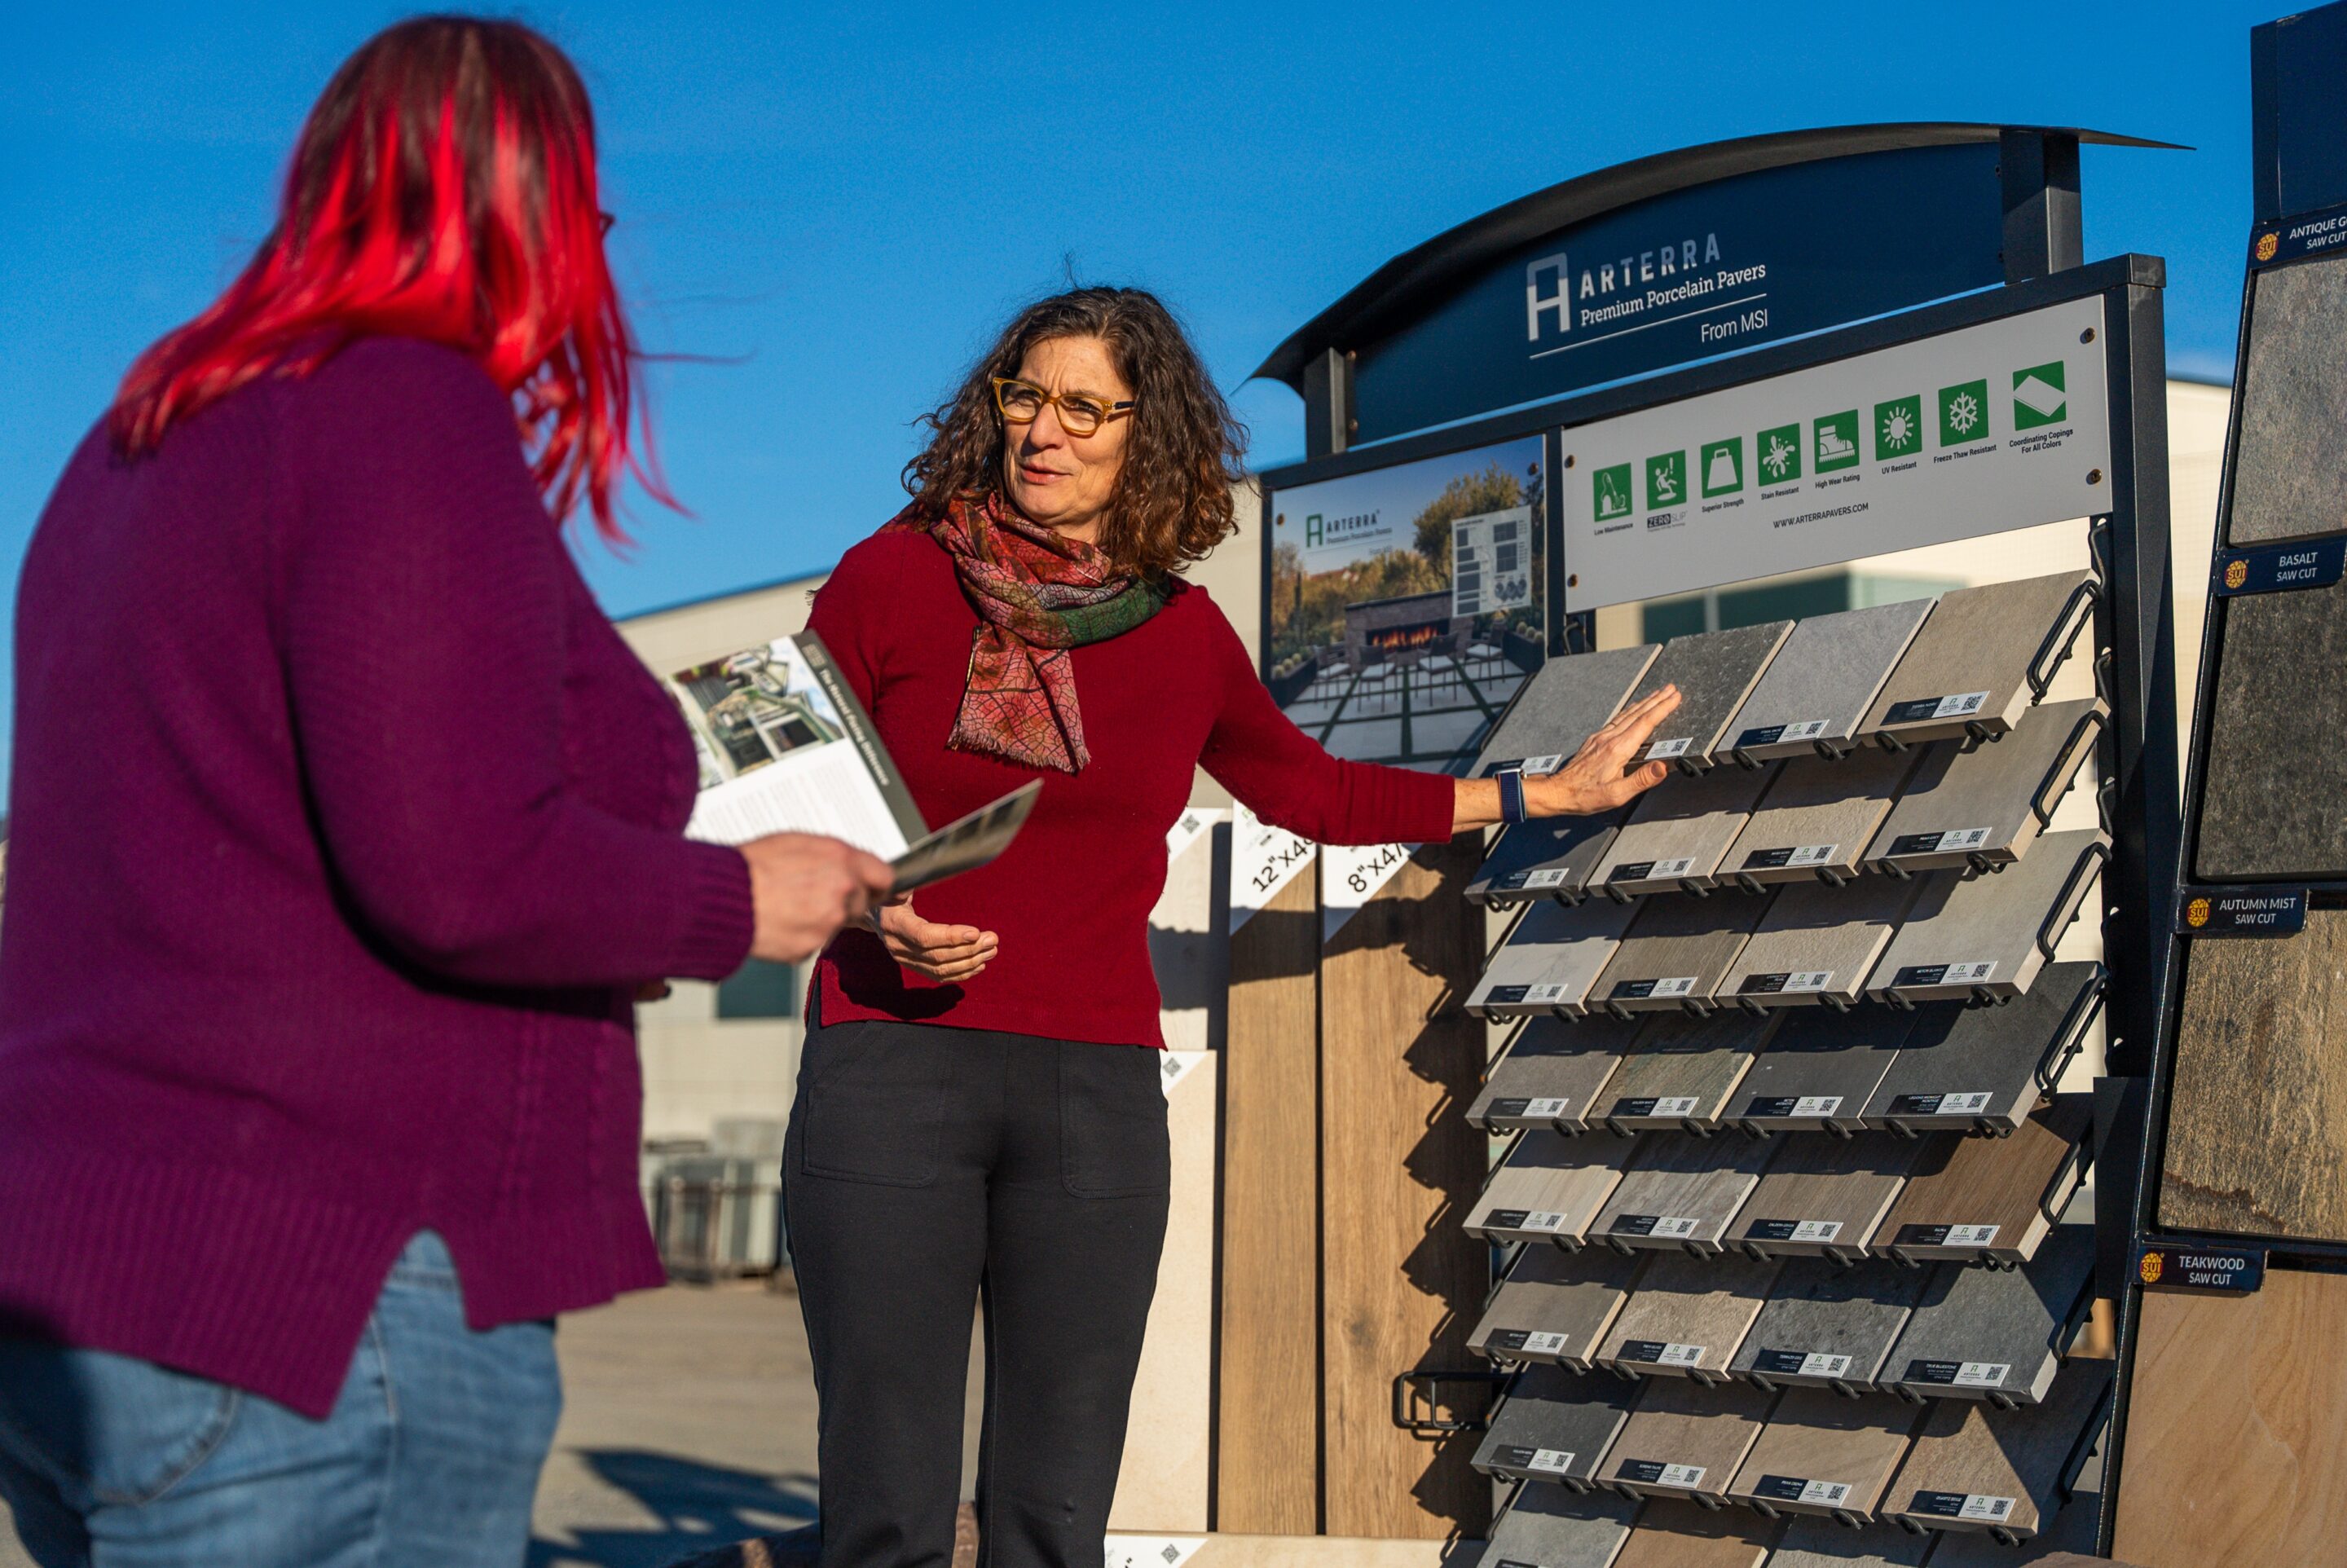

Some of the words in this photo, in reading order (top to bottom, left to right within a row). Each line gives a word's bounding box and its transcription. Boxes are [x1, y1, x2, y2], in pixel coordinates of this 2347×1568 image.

[2289, 218, 2337, 240] ANTIQUE
[2306, 236, 2327, 249] SAW
[2328, 231, 2347, 244] CUT
[1580, 233, 1720, 299] ARTERRA
[1581, 297, 1644, 327] Premium
[1647, 278, 1714, 308] Porcelain
[1717, 264, 1766, 289] Pavers
[1702, 319, 1738, 343] From
[1742, 309, 1768, 333] MSI
[2009, 434, 2048, 447] Coordinating
[2049, 428, 2074, 440] Copings
[2041, 440, 2062, 450] Colors
[1934, 454, 1953, 464] Freeze
[1953, 451, 1968, 460] Thaw
[1970, 444, 1997, 456] Resistant
[1891, 460, 1917, 473] Resistant
[1815, 480, 1828, 489] High
[1829, 478, 1842, 487] Wear
[1843, 473, 1860, 483] Rating
[1761, 491, 1775, 500] Stain
[1775, 487, 1799, 498] Resistant
[1326, 513, 1378, 533] ARTERRA
[1773, 503, 1869, 528] WWW.ARTERRAPAVERS.COM
[2279, 552, 2318, 567] BASALT
[2276, 570, 2296, 582] SAW
[2298, 567, 2318, 579] CUT
[2219, 898, 2267, 910] AUTUMN
[2270, 897, 2296, 909] MIST
[2235, 914, 2257, 924] SAW
[2257, 913, 2277, 923] CUT
[2179, 1256, 2245, 1271] TEAKWOOD
[2189, 1273, 2210, 1285] SAW
[2212, 1273, 2232, 1285] CUT
